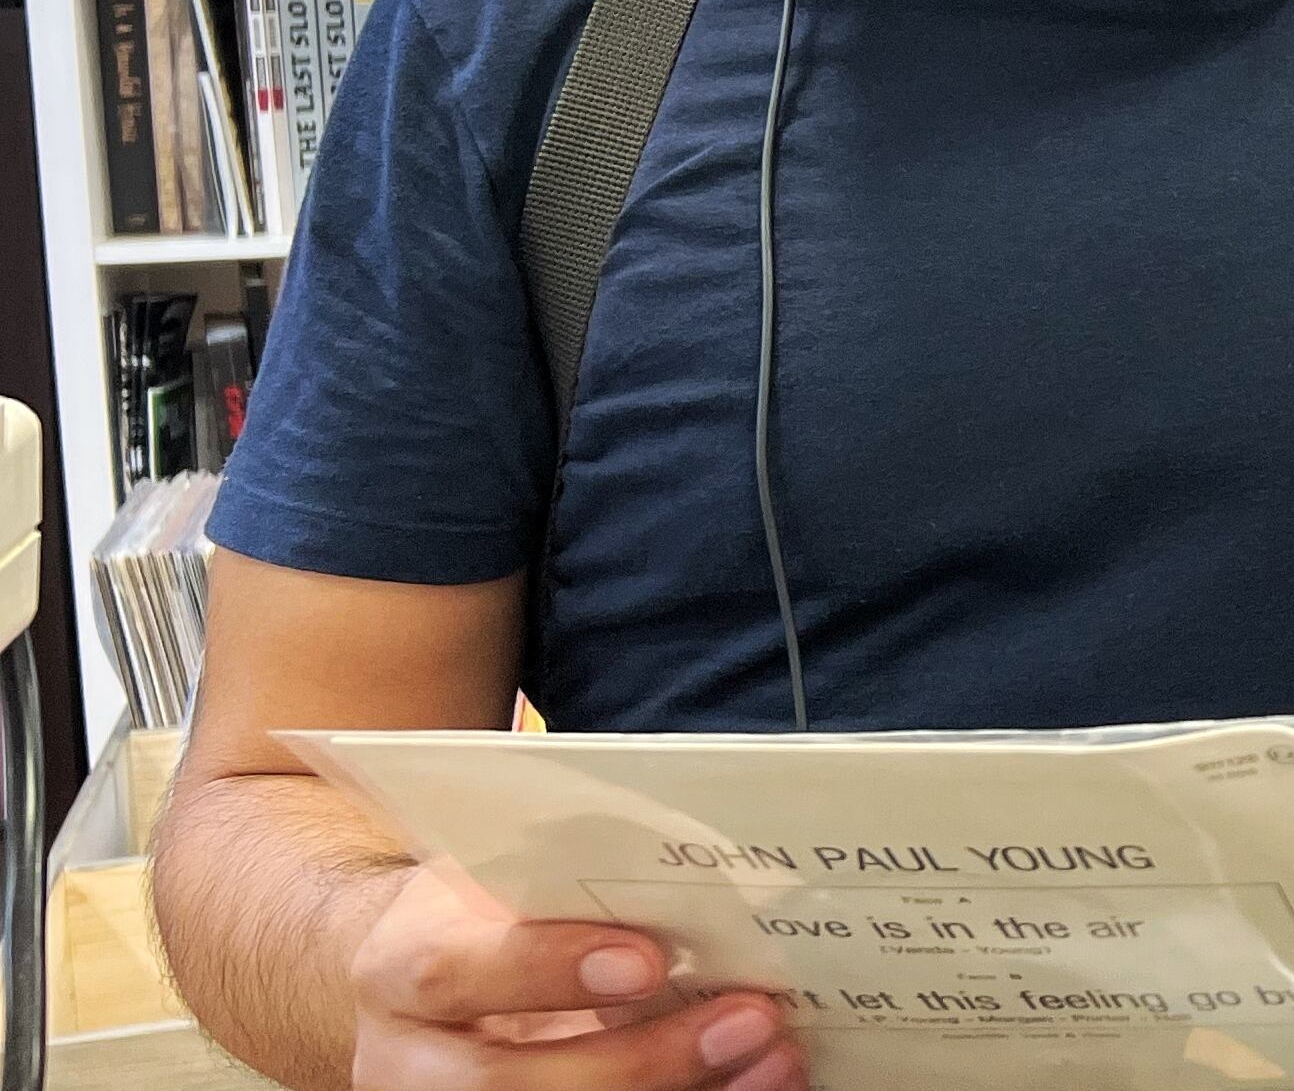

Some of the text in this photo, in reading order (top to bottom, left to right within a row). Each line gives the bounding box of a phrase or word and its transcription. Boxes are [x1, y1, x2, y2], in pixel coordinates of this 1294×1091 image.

[290, 53, 315, 114] LAST
[658, 842, 1156, 872] JOHN PAUL YOUNG
[753, 913, 1145, 939] love is in the air
[839, 989, 902, 1010] let
[916, 990, 1001, 1010] this
[1019, 989, 1169, 1012] feeling
[1188, 989, 1242, 1011] go
